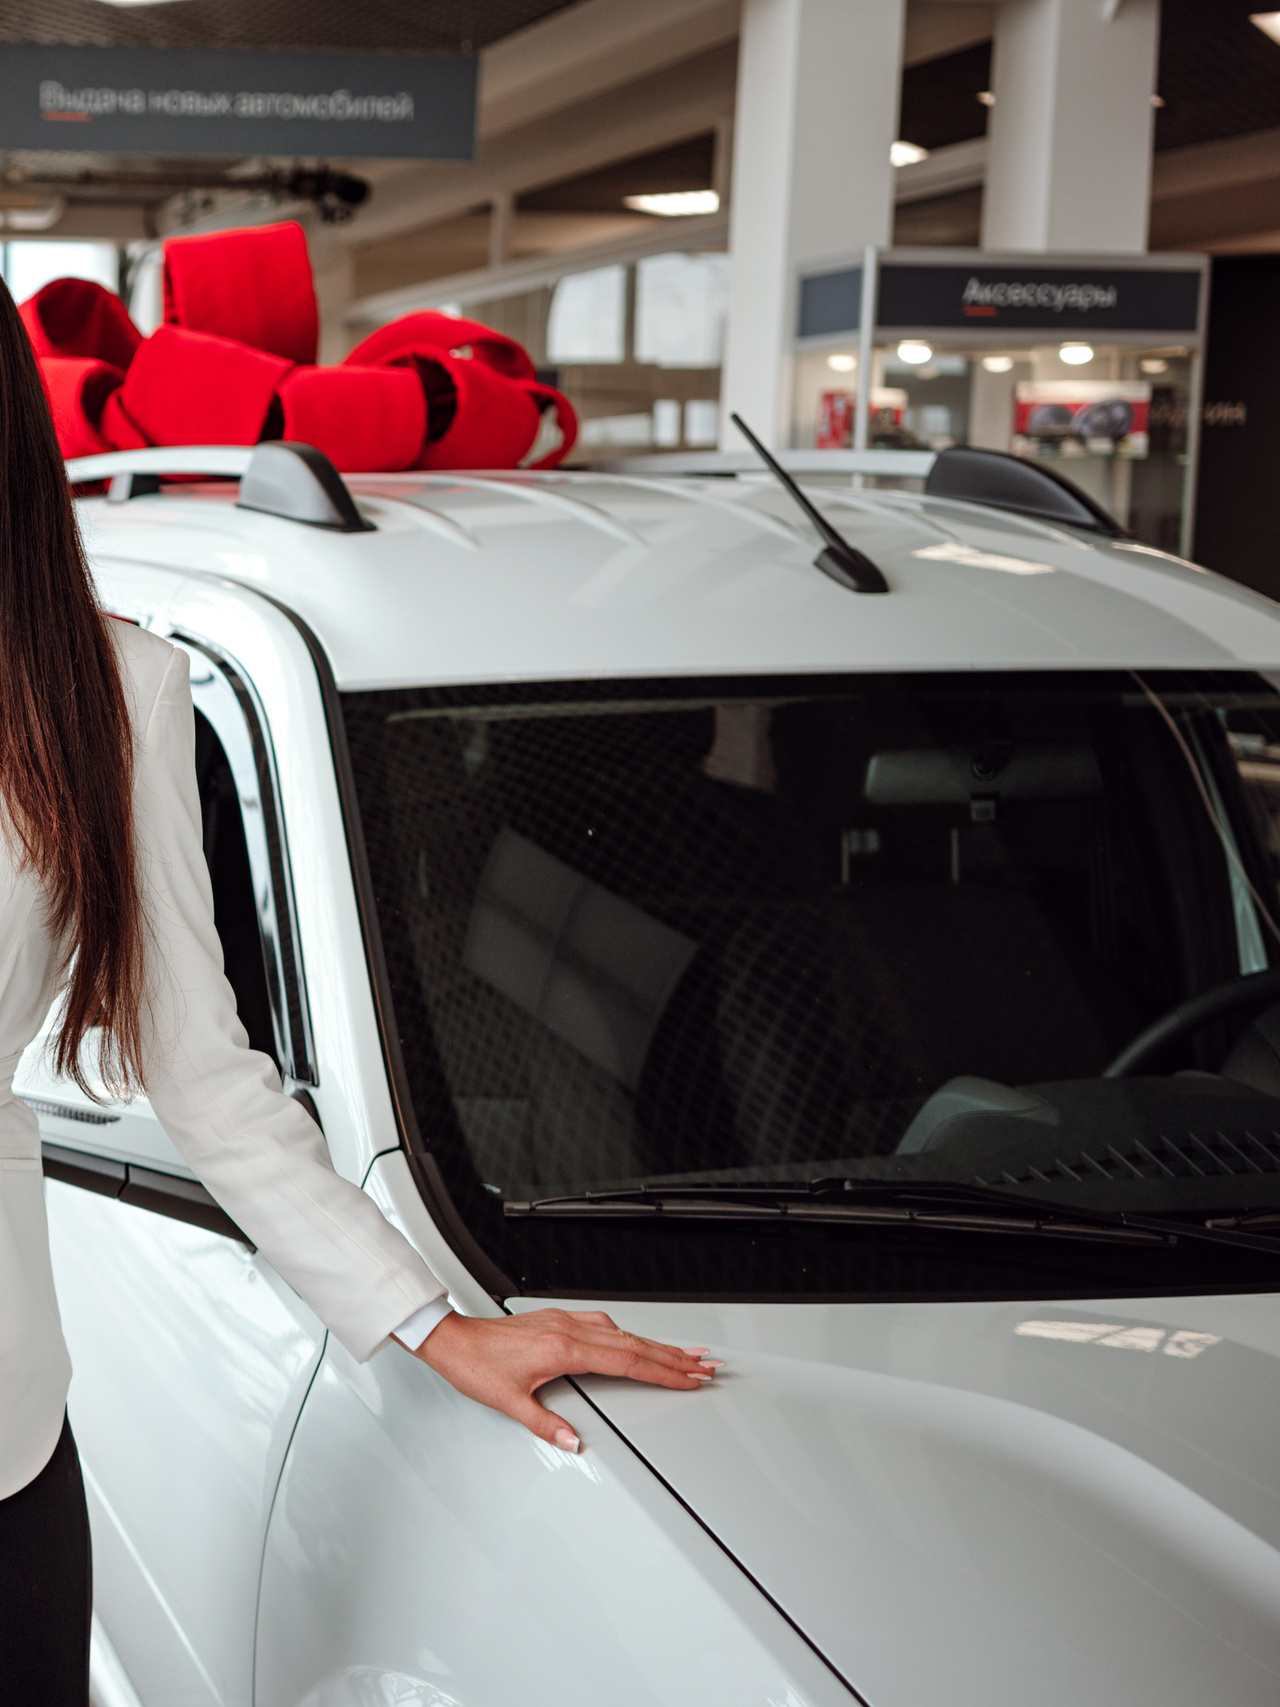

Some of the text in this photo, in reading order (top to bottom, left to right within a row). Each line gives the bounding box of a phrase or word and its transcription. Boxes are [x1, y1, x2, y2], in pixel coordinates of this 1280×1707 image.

[39, 80, 414, 122] Выдача новых автомобилей
[962, 277, 1118, 312] Аксессуары
